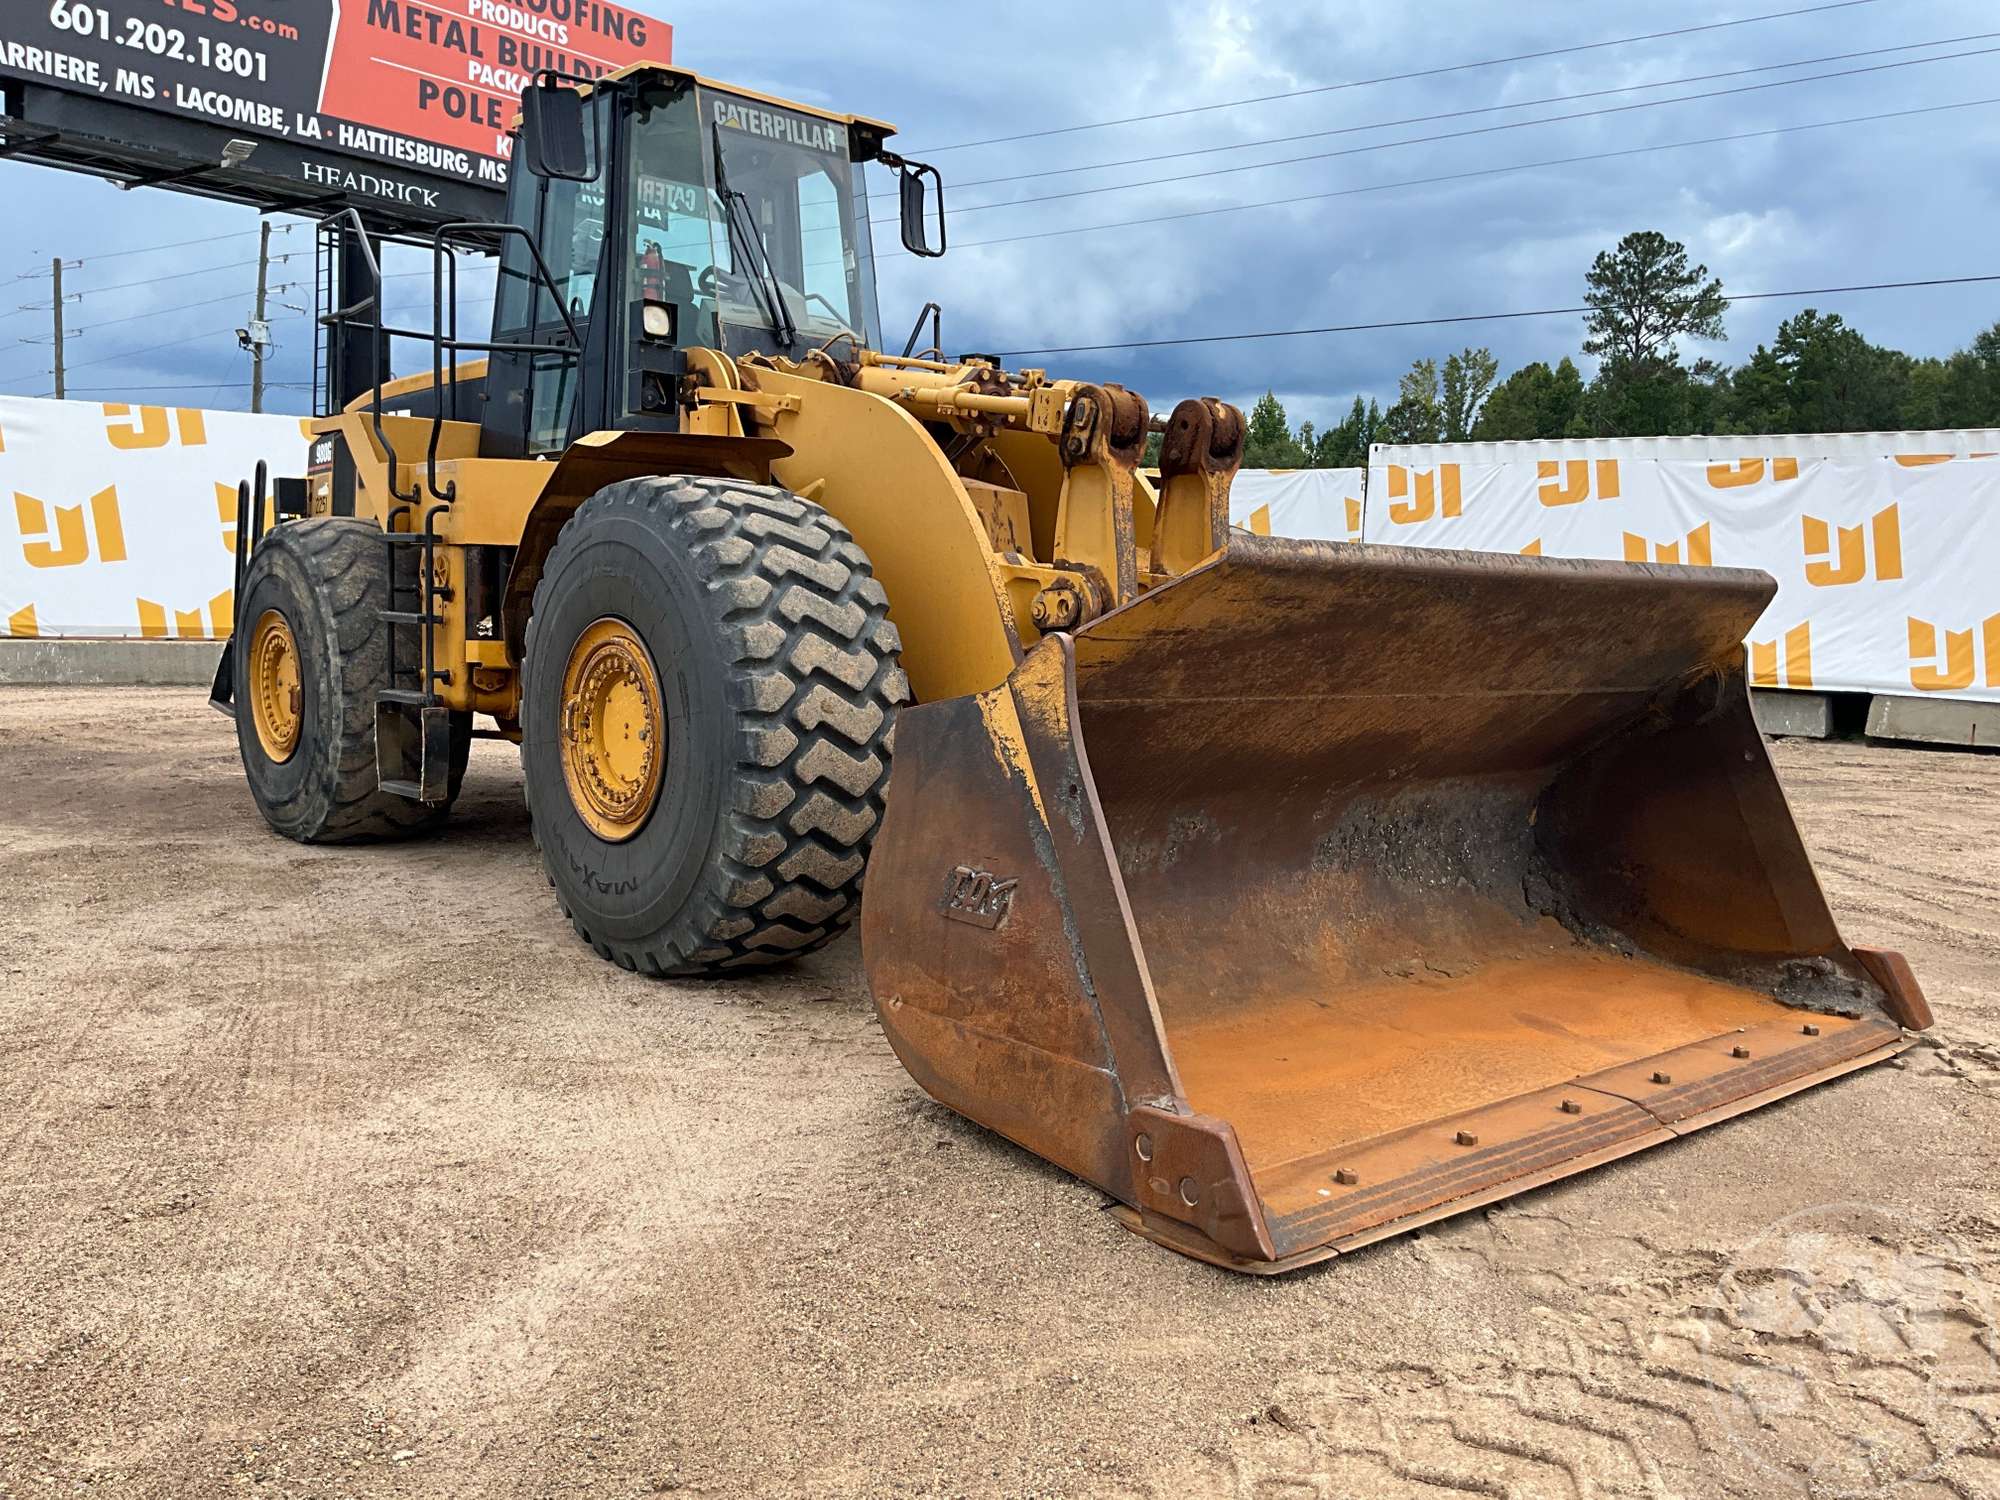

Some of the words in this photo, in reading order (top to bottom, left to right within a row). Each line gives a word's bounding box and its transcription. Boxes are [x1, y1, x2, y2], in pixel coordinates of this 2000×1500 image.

[50, 0, 267, 82] 601.202.1801
[367, 0, 484, 59] METAL
[468, 0, 569, 45] PRODUCTS
[115, 68, 155, 99] MS
[177, 83, 289, 136] LACOMBE,
[297, 113, 321, 140] LA
[339, 124, 474, 180] HATTIESBURG,
[478, 159, 508, 184] MS
[418, 78, 503, 130] POLE
[712, 99, 837, 153] CATERPILLAR
[301, 161, 441, 208] HEADRICK
